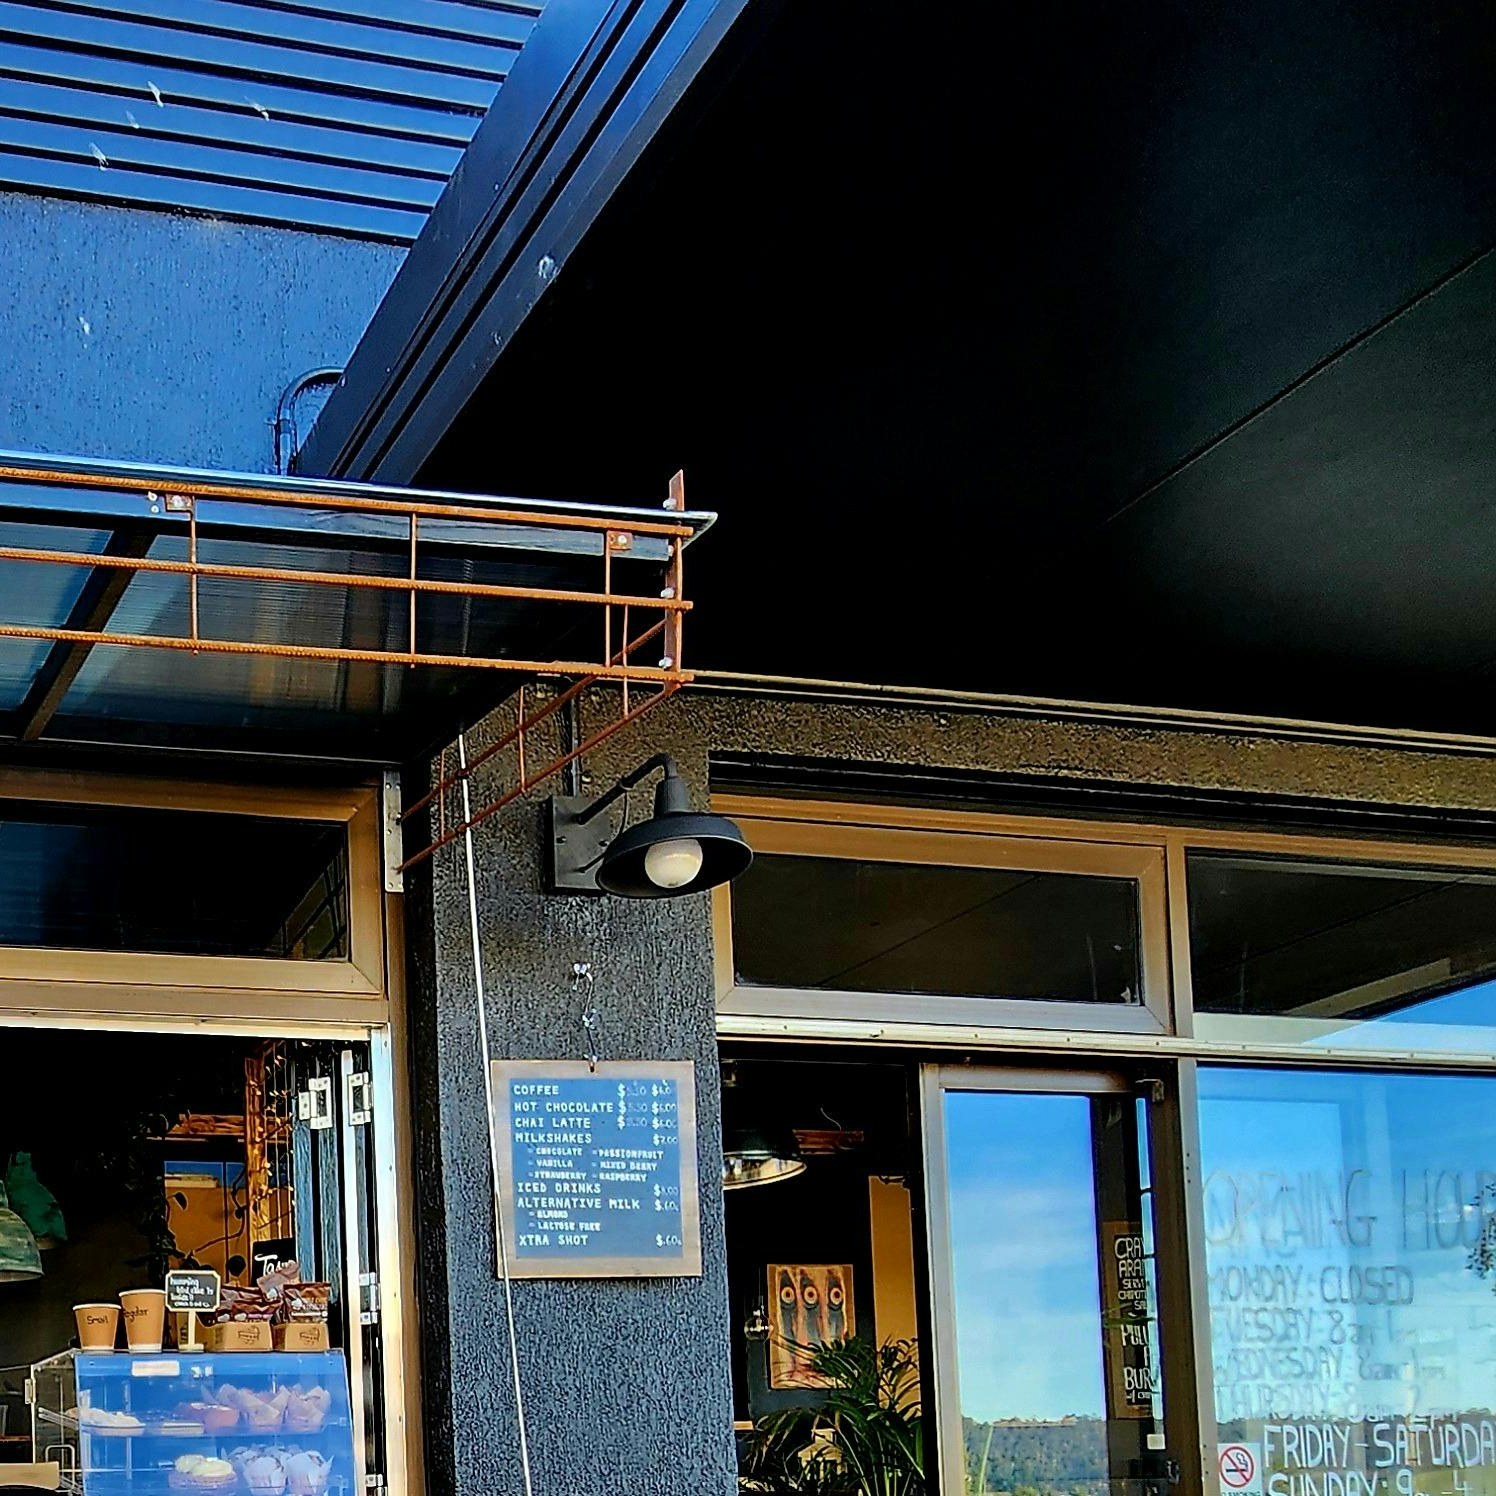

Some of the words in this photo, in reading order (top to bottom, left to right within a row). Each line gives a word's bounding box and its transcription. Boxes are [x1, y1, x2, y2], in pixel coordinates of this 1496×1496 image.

[514, 1085, 559, 1095] COFFEE
[514, 1102, 538, 1113] HOT
[546, 1102, 614, 1114] CHOCOLATE
[514, 1118, 544, 1128] CHAI
[552, 1118, 591, 1129] LATTE
[515, 1133, 592, 1144] MILKSHAKES
[518, 1183, 547, 1194] ICED
[554, 1183, 602, 1194] DRINKS
[517, 1198, 602, 1210] ALTERNATIVE
[609, 1198, 640, 1210] MILK
[538, 1222, 575, 1230] LACTOSE
[579, 1222, 601, 1232] FREE
[519, 1234, 550, 1246] XTRA
[558, 1234, 588, 1246] SHOT
[1320, 1265, 1415, 1305] CLOSED
[1264, 1424, 1350, 1468] FRIDAY
[1373, 1423, 1496, 1469] SATURDA
